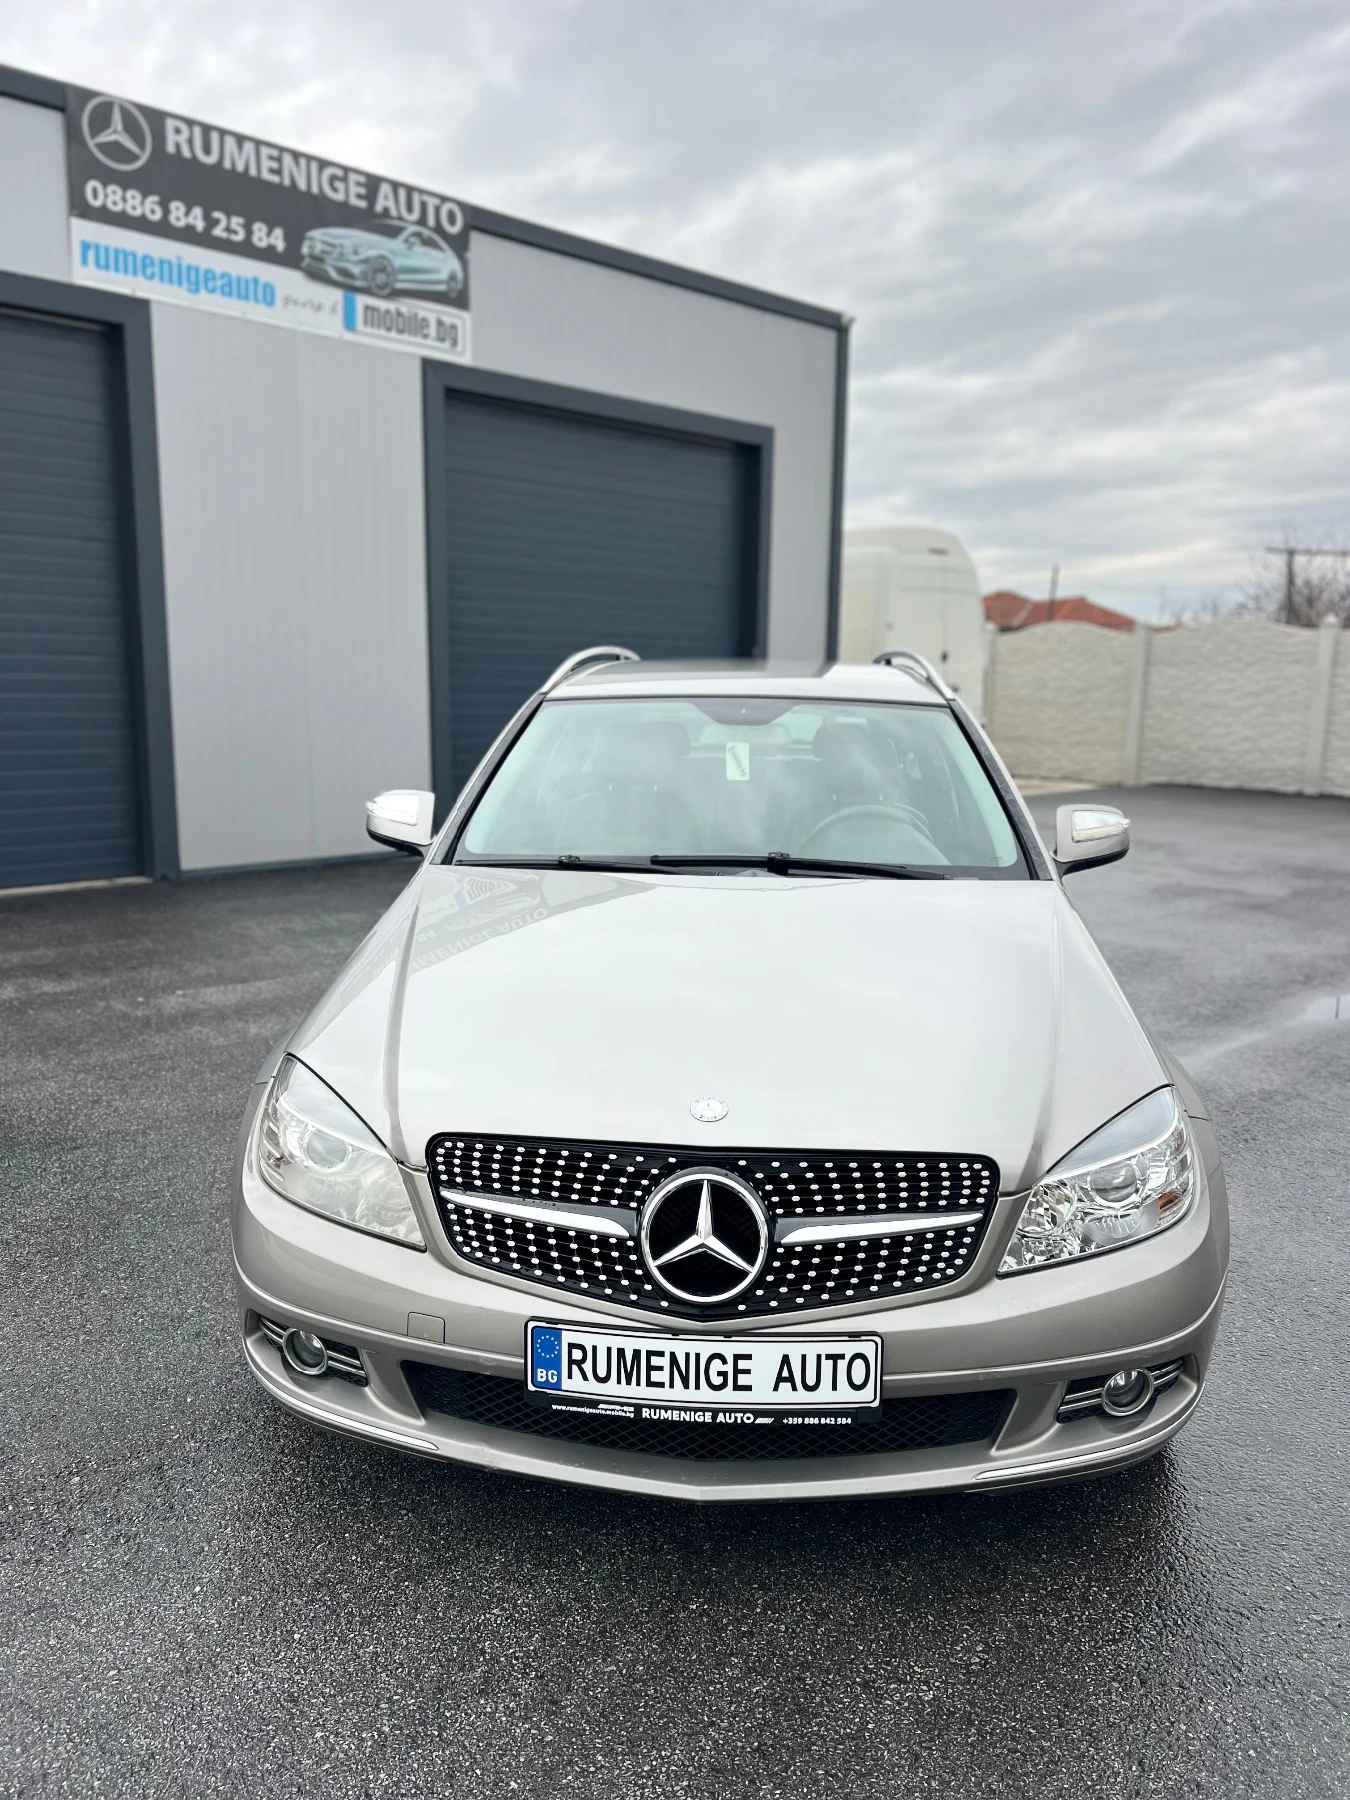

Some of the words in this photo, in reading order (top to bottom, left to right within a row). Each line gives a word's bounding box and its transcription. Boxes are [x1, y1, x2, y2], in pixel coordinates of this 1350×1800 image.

[165, 117, 368, 209] RUMENIGE
[374, 185, 464, 236] AUTO
[84, 179, 164, 222] 0886
[168, 199, 206, 233] 84
[211, 211, 247, 243] 25
[251, 224, 286, 253] 84
[79, 239, 277, 308] rumenigeauto
[363, 303, 458, 349] mobile.bg
[536, 1368, 558, 1384] BG
[567, 1342, 753, 1392] RUMENIGE
[772, 1352, 872, 1392] AUTO
[641, 1407, 713, 1423] RUMENIGE
[716, 1411, 755, 1424] AUTO
[782, 1416, 803, 1425] +359
[804, 1416, 820, 1425] 886
[820, 1416, 836, 1425] 842
[836, 1416, 853, 1425] 584
